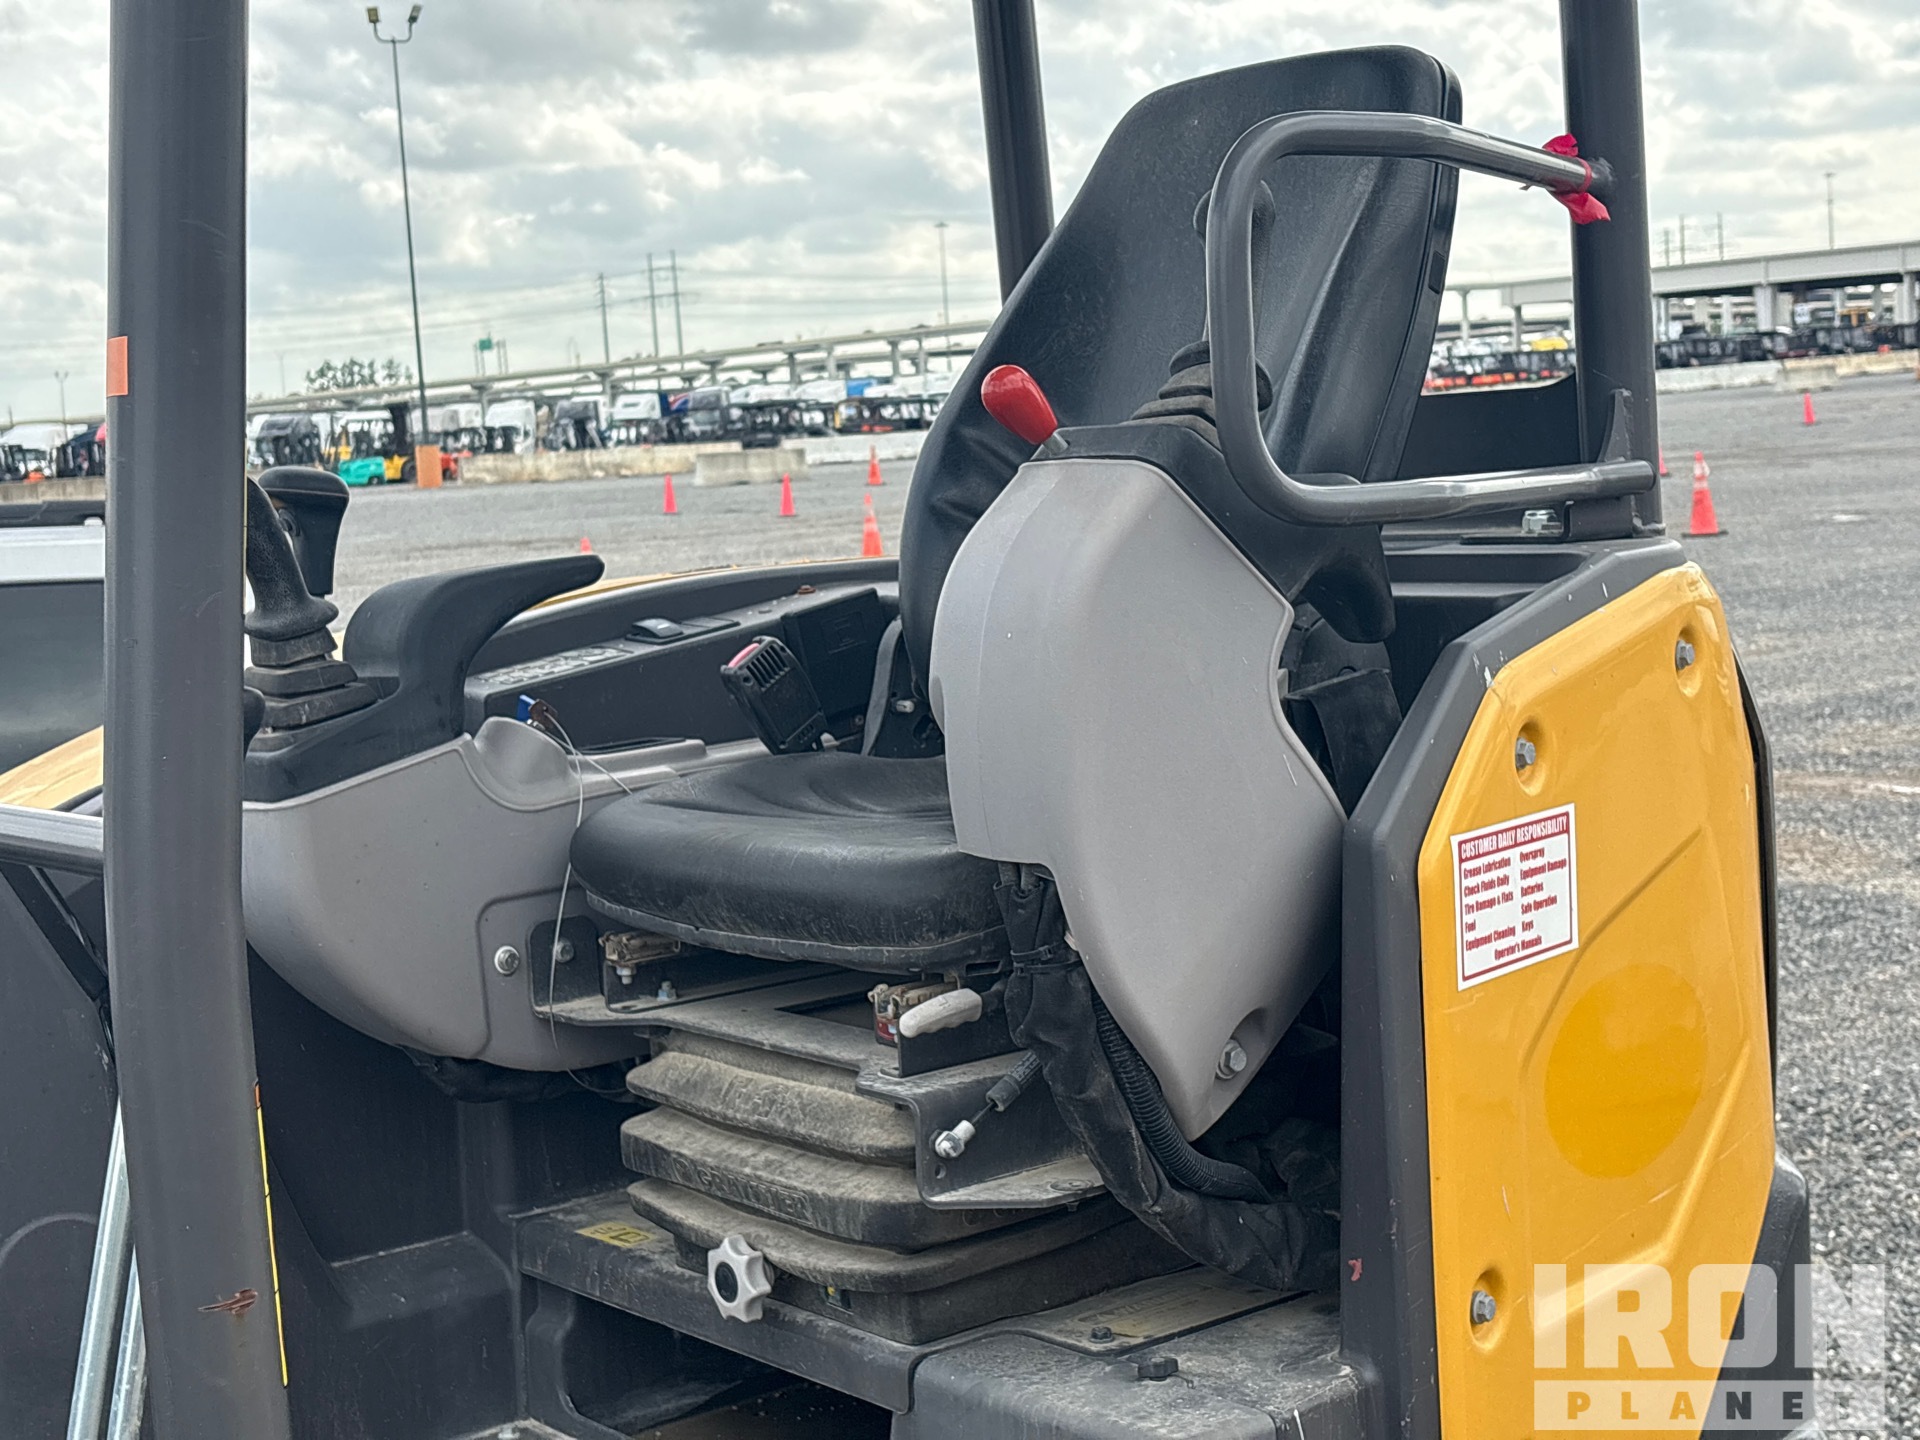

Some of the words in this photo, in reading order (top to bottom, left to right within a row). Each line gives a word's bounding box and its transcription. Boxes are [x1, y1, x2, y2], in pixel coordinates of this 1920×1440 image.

[1461, 836, 1497, 859] CUSTOMER
[1498, 830, 1515, 849] DAILY
[1516, 815, 1567, 843] RESPONSIBILITY
[1463, 866, 1481, 880] Grease
[1482, 857, 1511, 874] Lubrication
[1520, 863, 1546, 880] Equipment
[1547, 858, 1567, 872] Damage
[1464, 883, 1480, 898] Check
[1480, 878, 1496, 892] Fluids
[1497, 874, 1510, 888] Daily
[1520, 882, 1544, 897] Batteries
[1464, 902, 1475, 916] Tire
[1475, 897, 1496, 912] Damage
[1501, 891, 1514, 904] Flats
[1521, 902, 1532, 915] Safe
[1533, 895, 1557, 911] Operation
[1465, 919, 1476, 933] Fuel
[1521, 920, 1534, 933] Keys
[1465, 932, 1493, 951] Equipment
[1493, 926, 1516, 942] Cleaning
[1494, 942, 1520, 960] Operator's
[1520, 935, 1542, 951] Manuals
